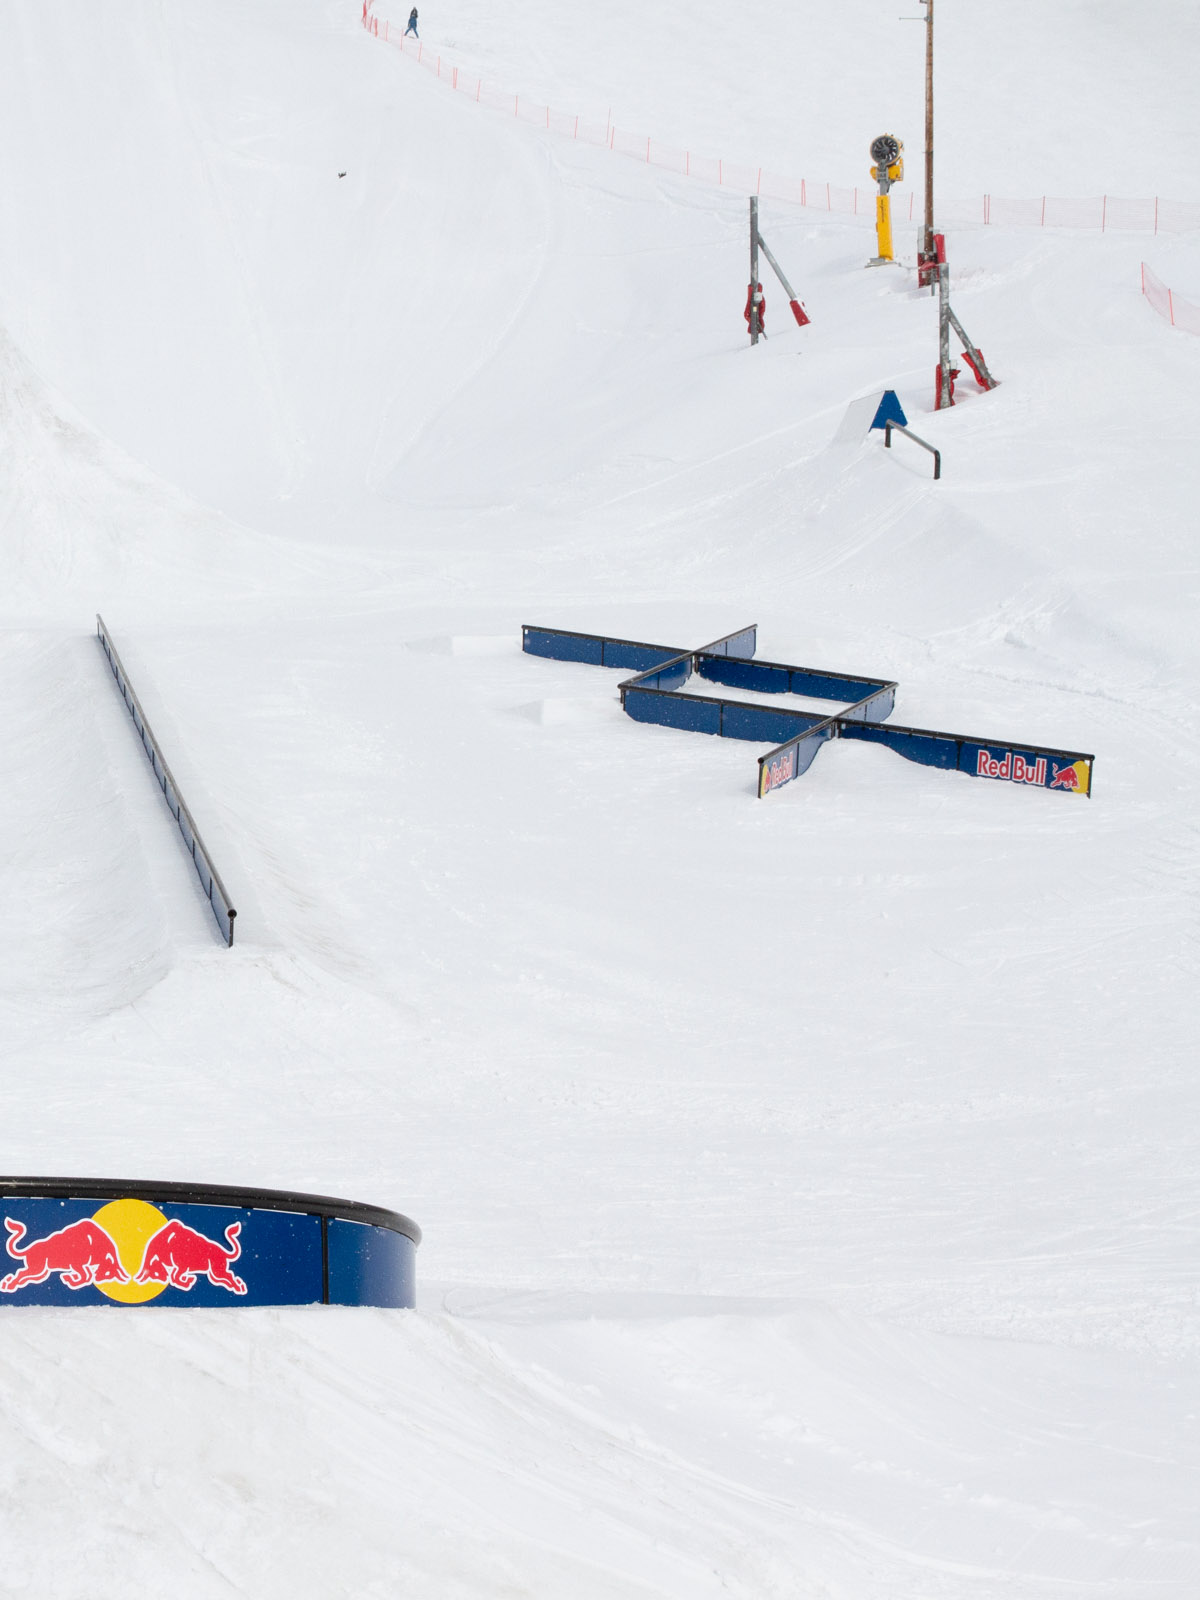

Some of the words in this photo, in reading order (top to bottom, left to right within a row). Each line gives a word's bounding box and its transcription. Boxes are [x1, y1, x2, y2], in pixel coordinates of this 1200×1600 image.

[771, 758, 783, 787] Red
[977, 750, 1011, 779] Red
[1013, 755, 1047, 785] Bull
